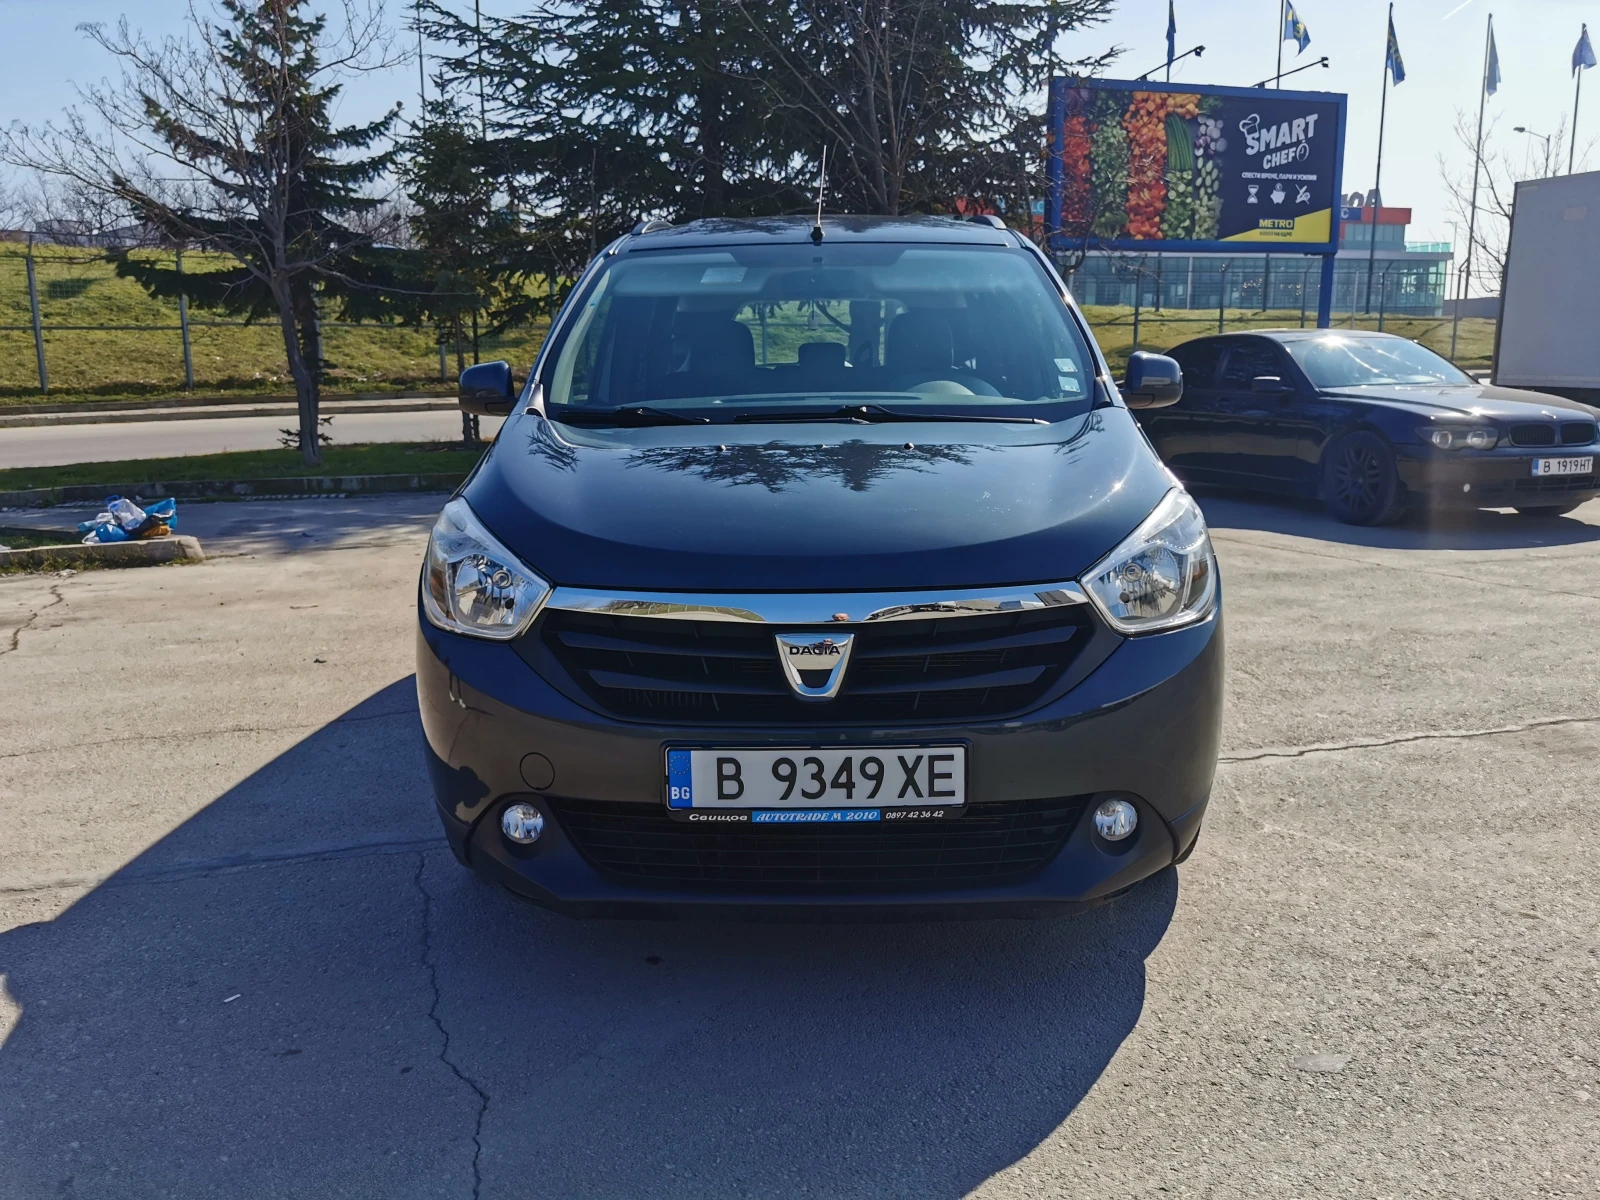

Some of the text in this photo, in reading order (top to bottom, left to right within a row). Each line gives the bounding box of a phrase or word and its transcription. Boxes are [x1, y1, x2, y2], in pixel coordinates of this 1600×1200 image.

[1246, 114, 1318, 155] SMART
[1263, 147, 1297, 169] CHEF
[1259, 219, 1293, 228] METRO
[1543, 461, 1551, 473] B
[789, 645, 840, 655] DACIA
[716, 757, 745, 800] B
[671, 786, 690, 800] BG
[757, 811, 878, 821] AUTOTRADE M 2010
[885, 811, 906, 819] 0897
[920, 810, 931, 818] 36
[932, 810, 944, 818] 42
